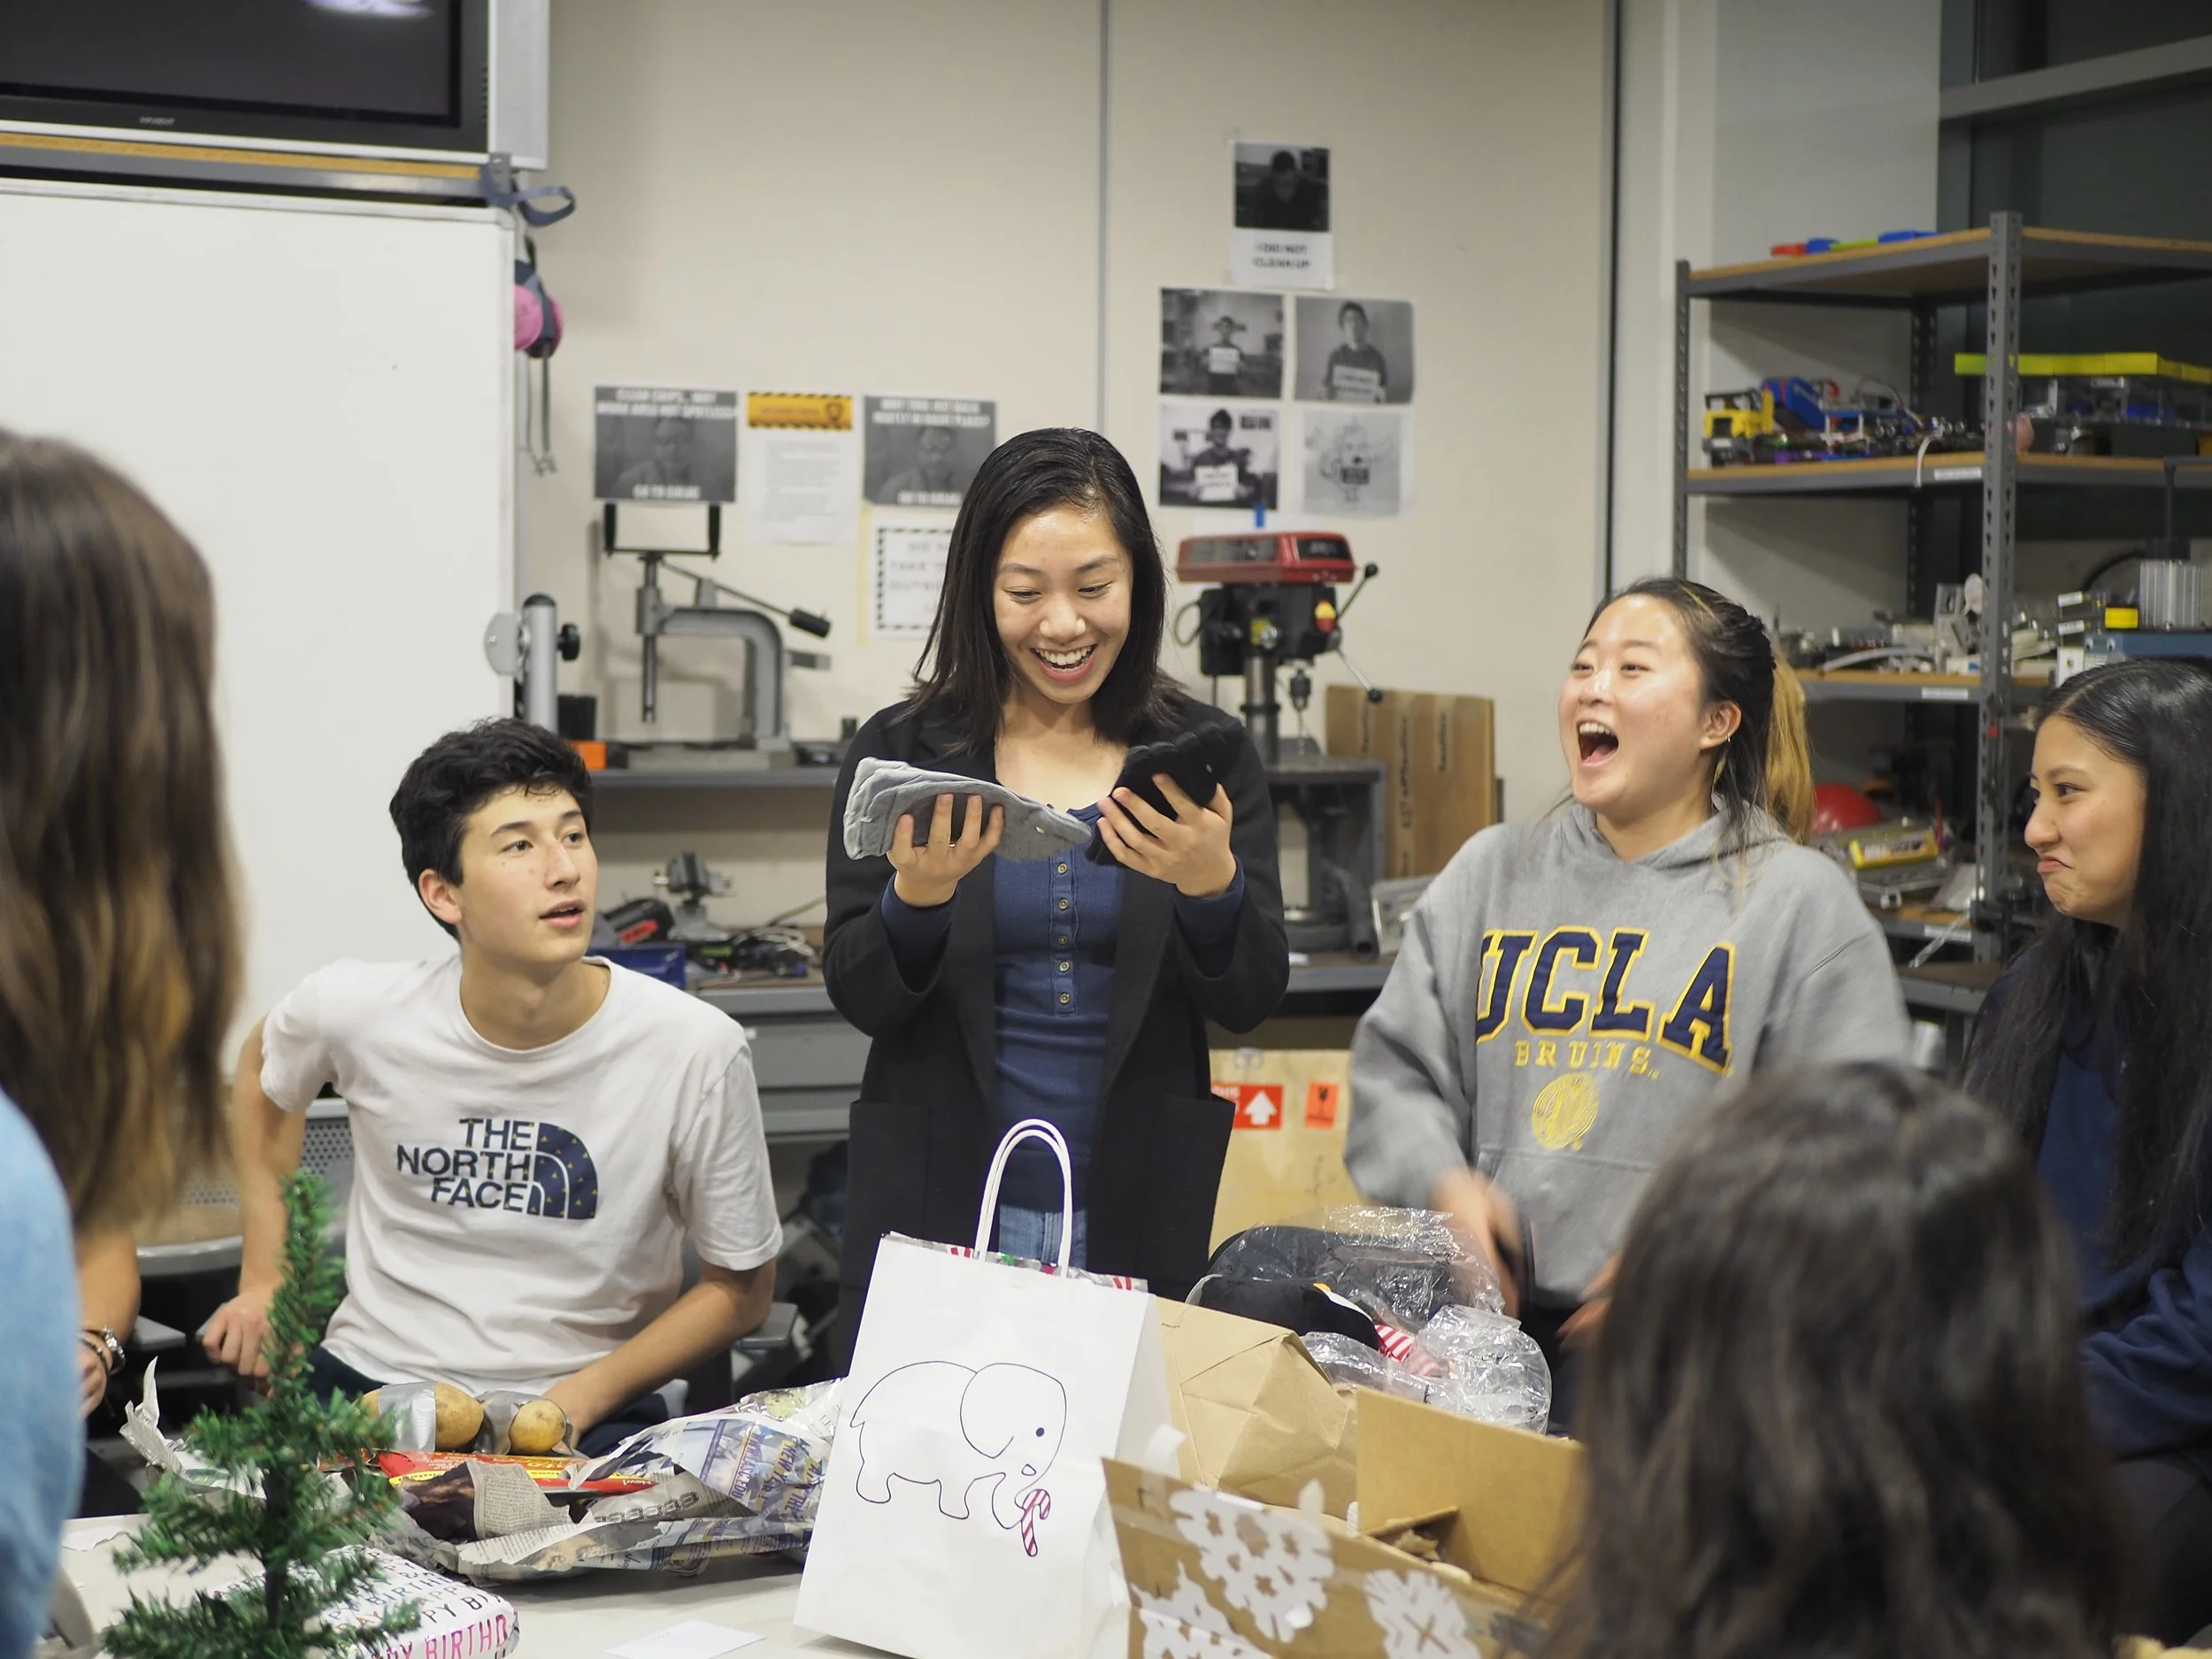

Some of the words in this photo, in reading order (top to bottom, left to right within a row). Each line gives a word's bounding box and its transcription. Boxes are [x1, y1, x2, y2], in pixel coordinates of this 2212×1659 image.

[1475, 925, 1736, 1076] UCLA
[1514, 1040, 1652, 1075] BRUINS
[459, 1118, 534, 1151] THE
[396, 1143, 531, 1181] NORTH
[430, 1176, 528, 1213] FACE
[426, 1613, 511, 1659] BIRTHD
